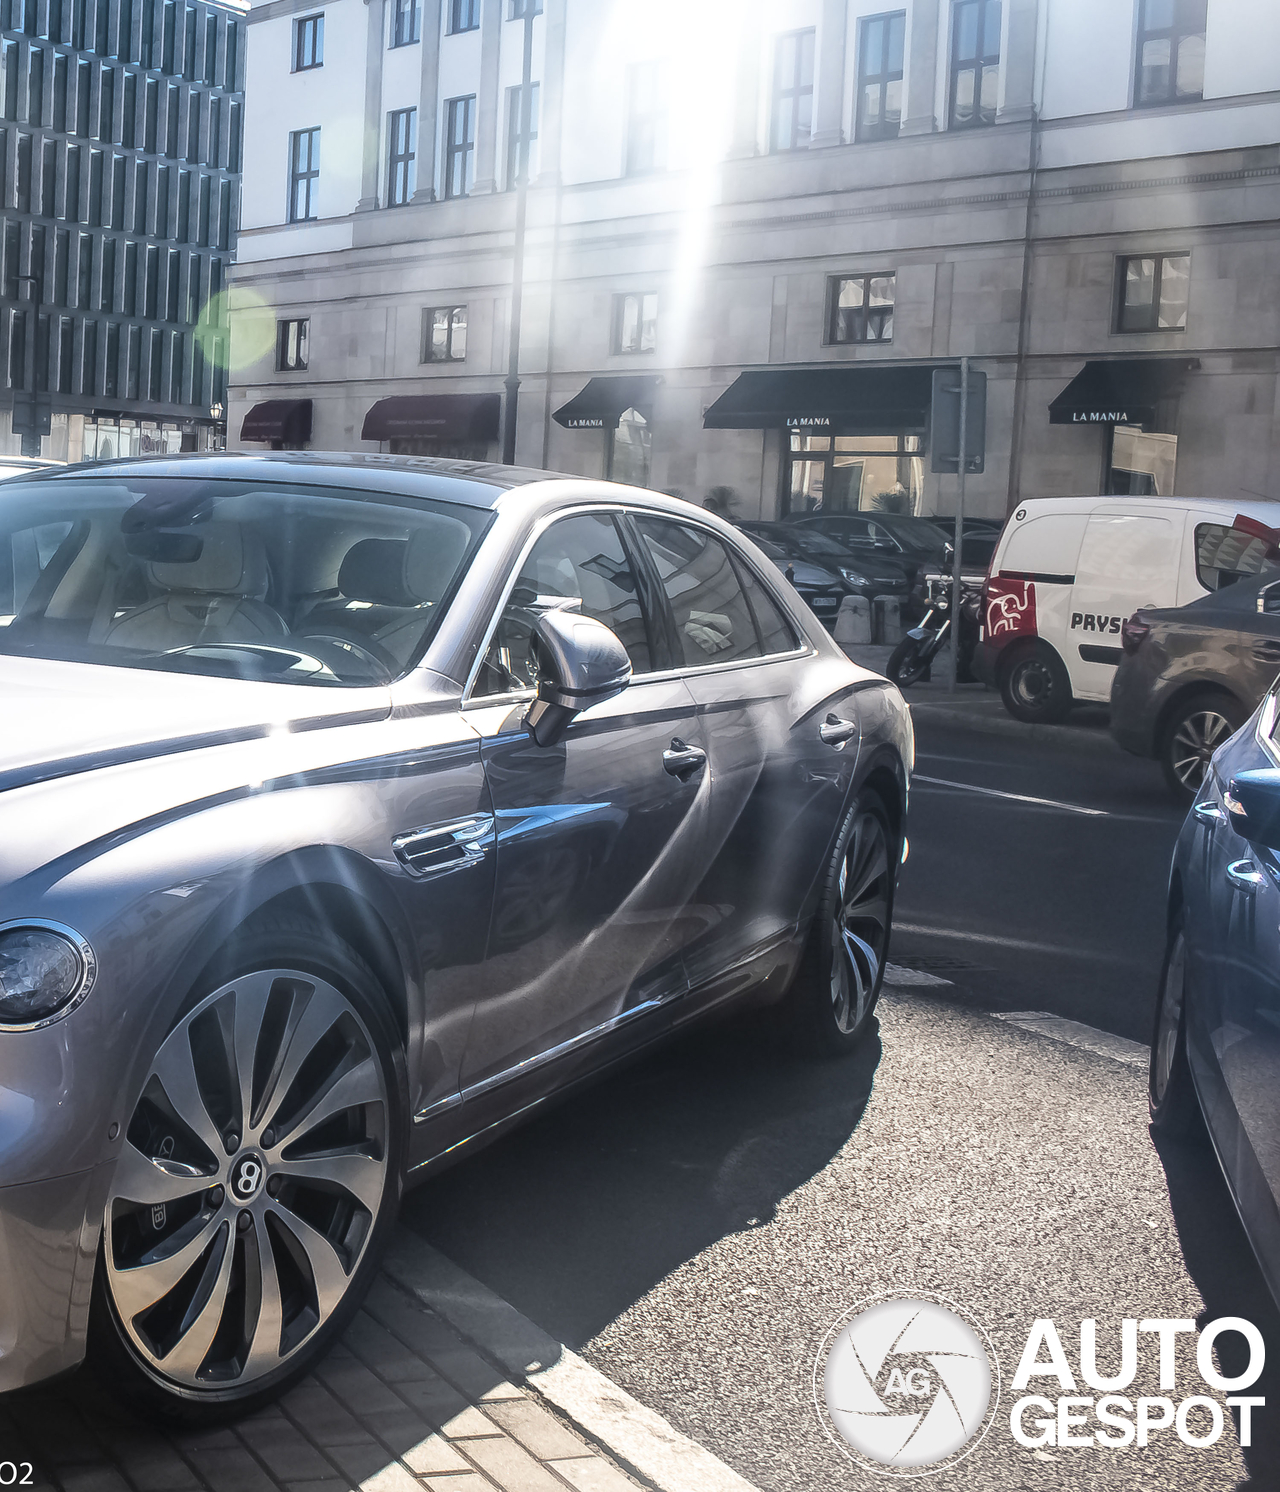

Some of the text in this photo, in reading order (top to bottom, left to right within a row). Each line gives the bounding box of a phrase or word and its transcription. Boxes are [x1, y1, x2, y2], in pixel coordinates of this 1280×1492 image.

[1072, 412, 1128, 421] LA MANIA
[786, 417, 830, 426] LA MANIA
